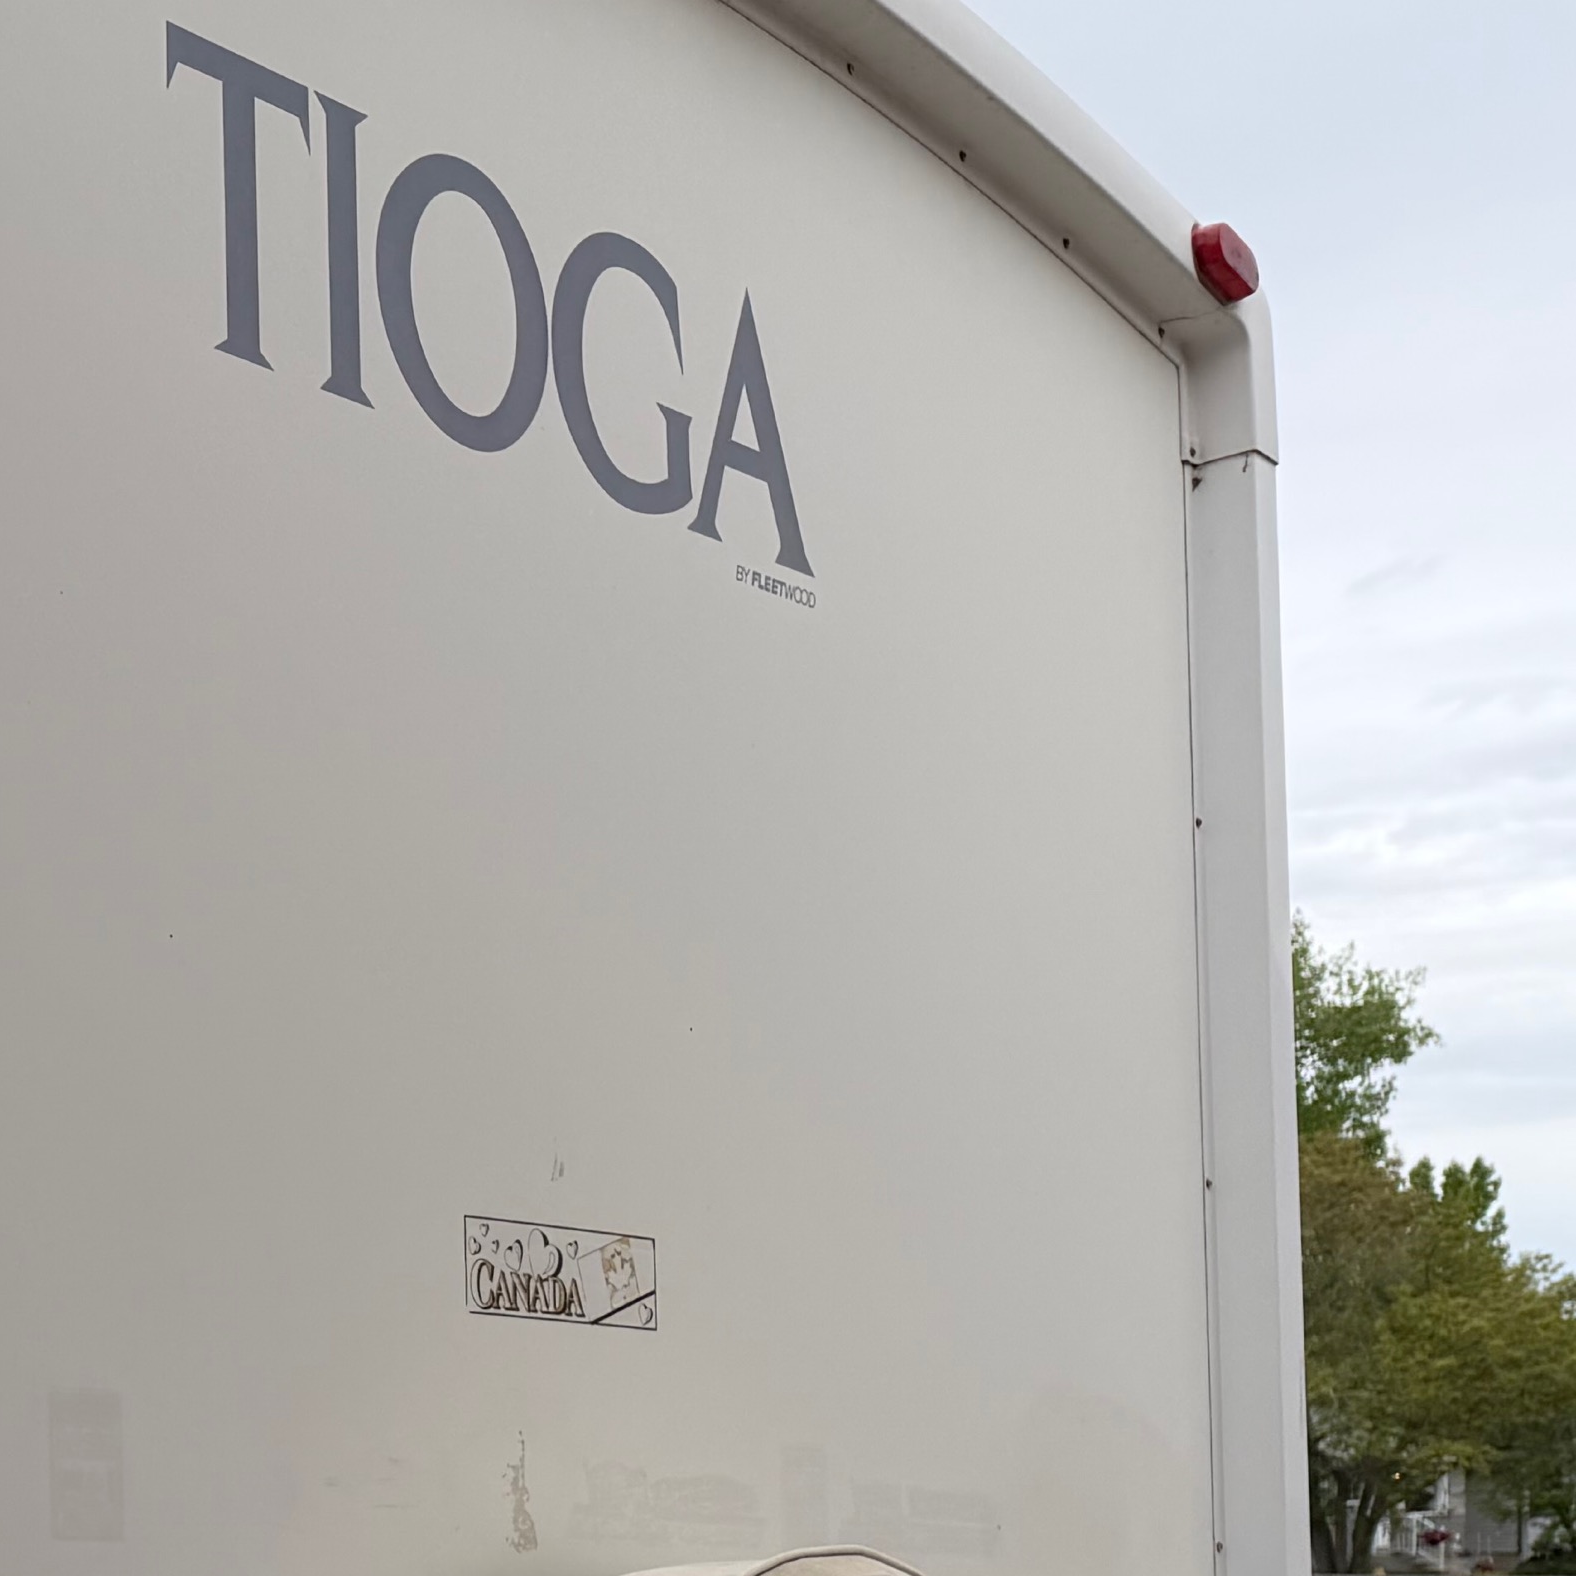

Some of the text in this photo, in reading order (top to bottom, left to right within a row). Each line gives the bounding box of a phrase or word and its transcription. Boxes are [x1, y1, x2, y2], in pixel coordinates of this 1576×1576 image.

[165, 20, 815, 578] TIOGA
[736, 565, 816, 608] BY FLEETWOOD
[470, 1258, 585, 1316] CANADA
